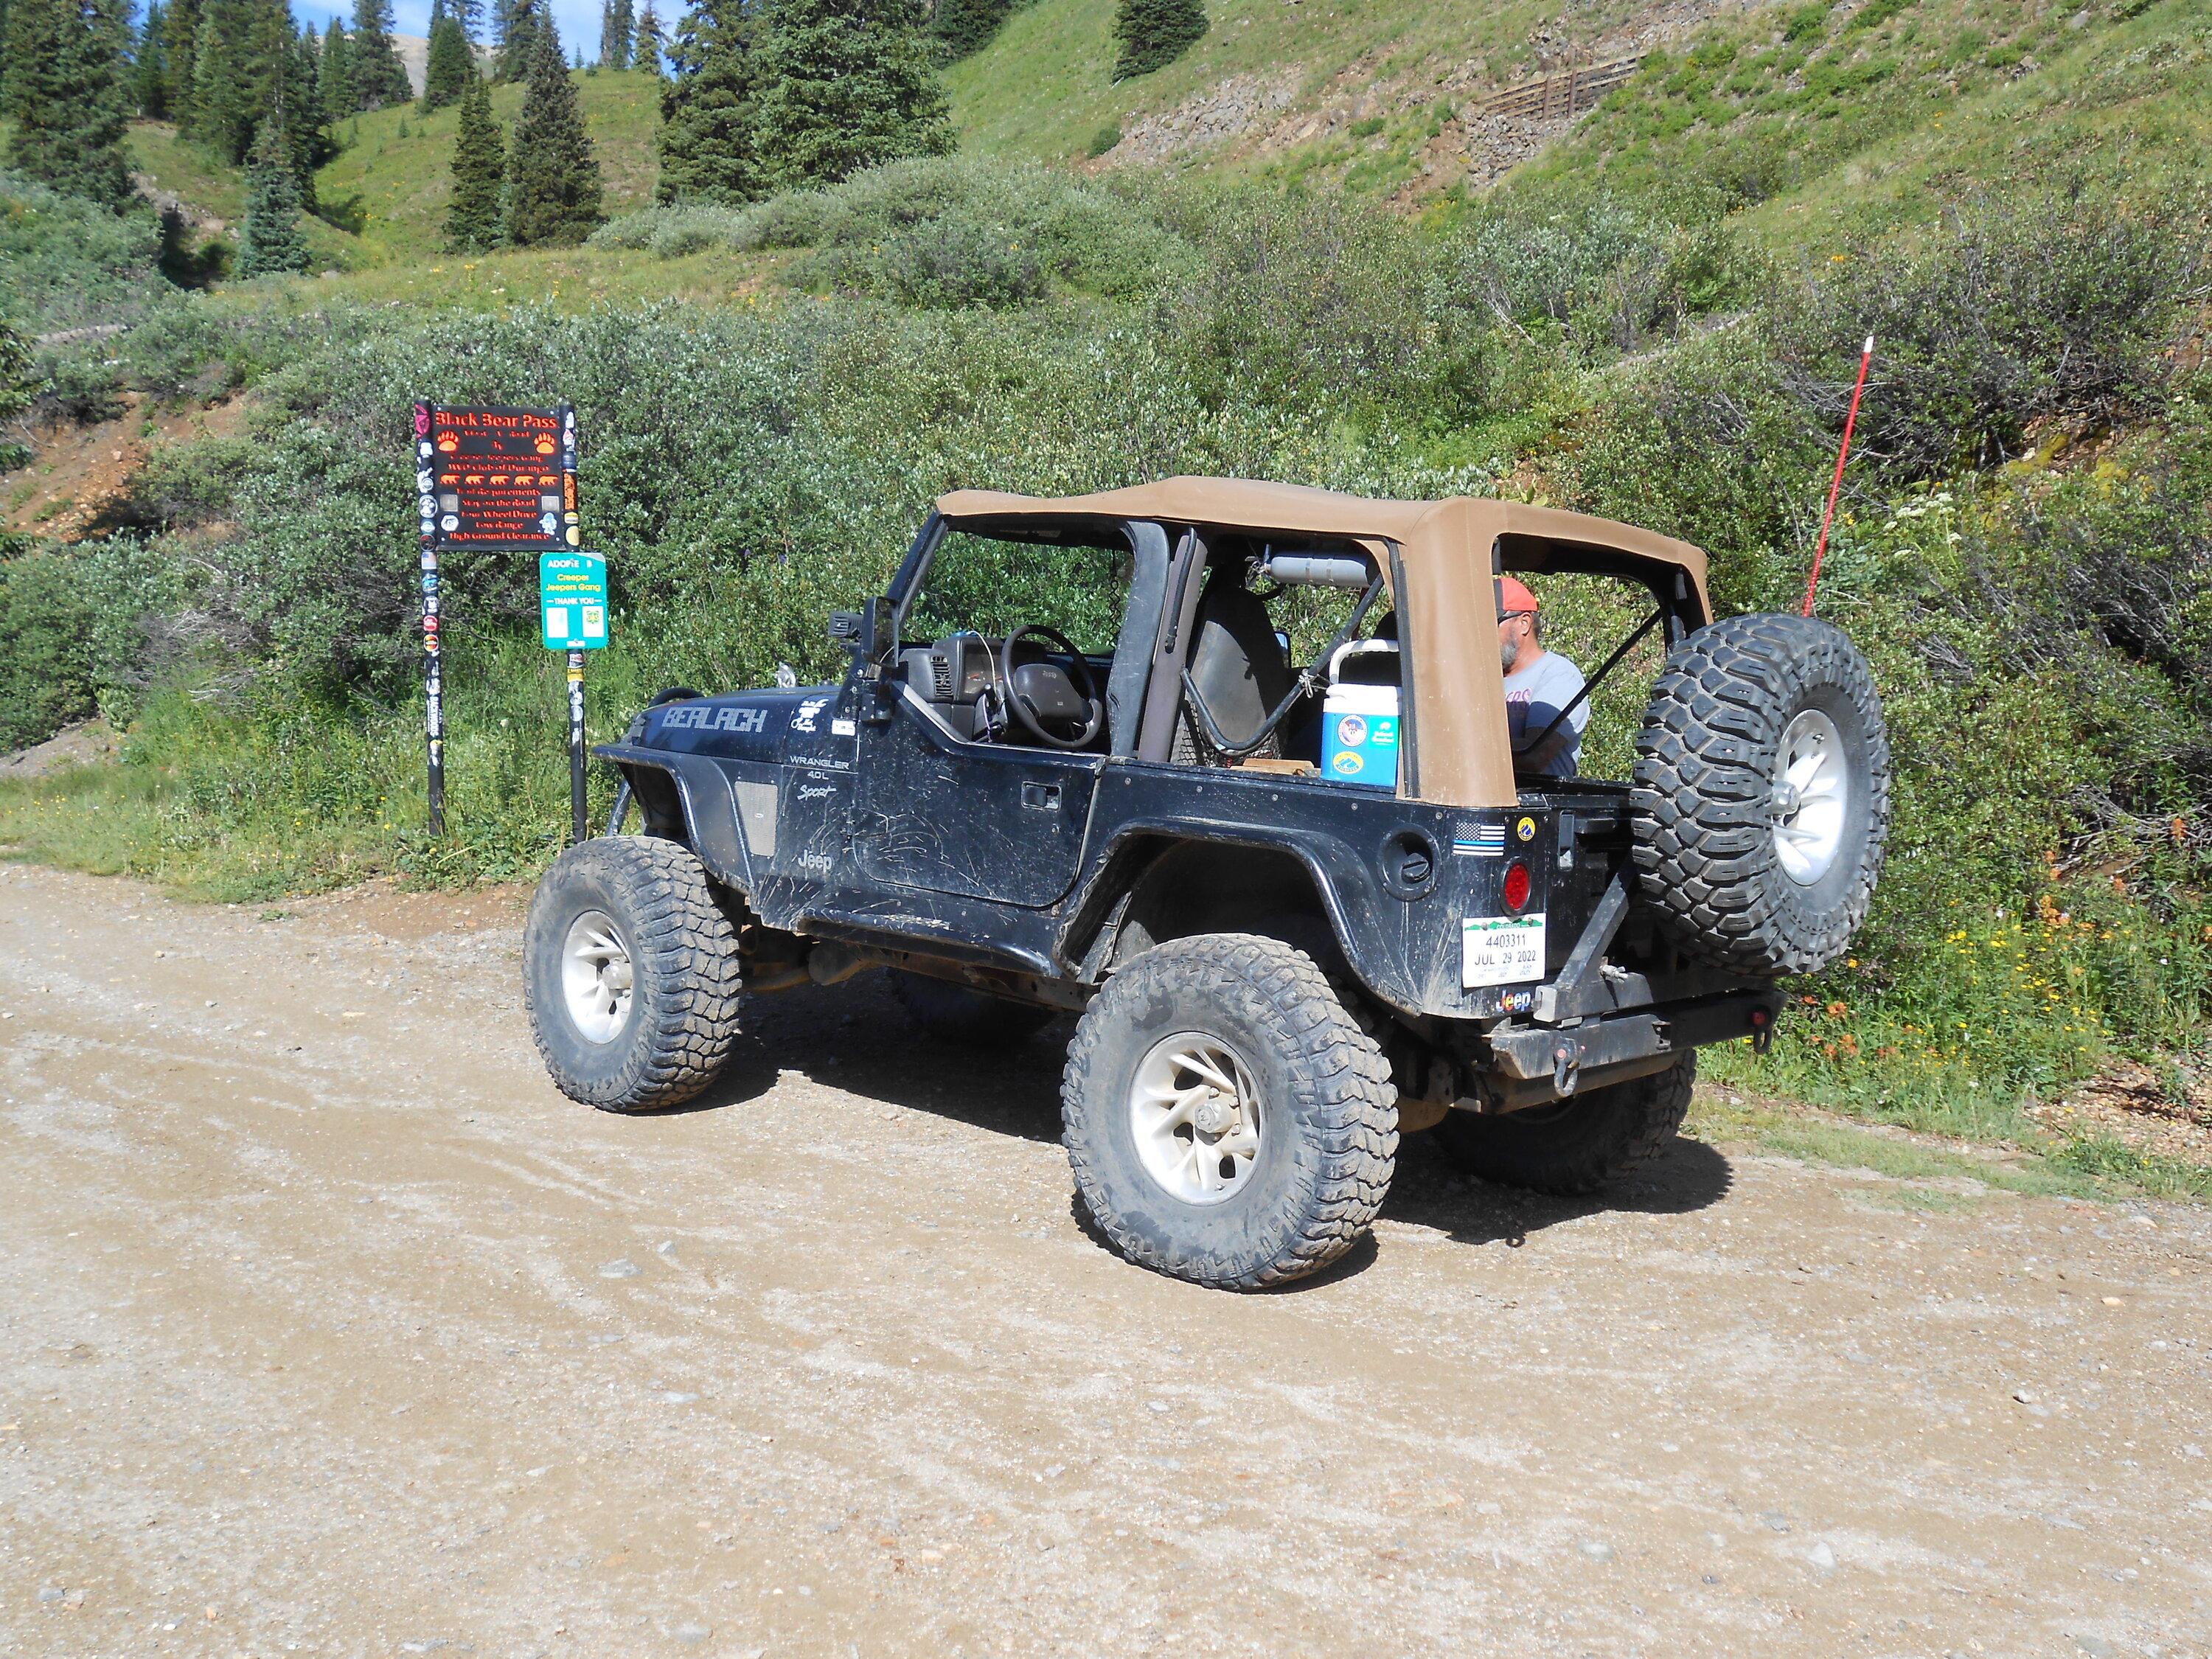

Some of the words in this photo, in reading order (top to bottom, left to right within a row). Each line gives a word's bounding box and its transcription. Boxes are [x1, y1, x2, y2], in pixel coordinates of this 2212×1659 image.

[436, 412, 478, 426] Black
[482, 413, 518, 427] Bear
[523, 414, 557, 428] Pass
[577, 583, 602, 593] Gang
[554, 597, 578, 605] THANK
[661, 706, 768, 733] BEALACH
[789, 755, 849, 770] WRANGLER
[797, 784, 837, 801] Sport
[798, 849, 832, 871] Jeep
[1486, 933, 1526, 948] 4403311
[1475, 953, 1495, 965] JUL
[1503, 952, 1512, 964] 29
[1517, 950, 1536, 963] 2022
[1496, 989, 1531, 1012] Jeep
